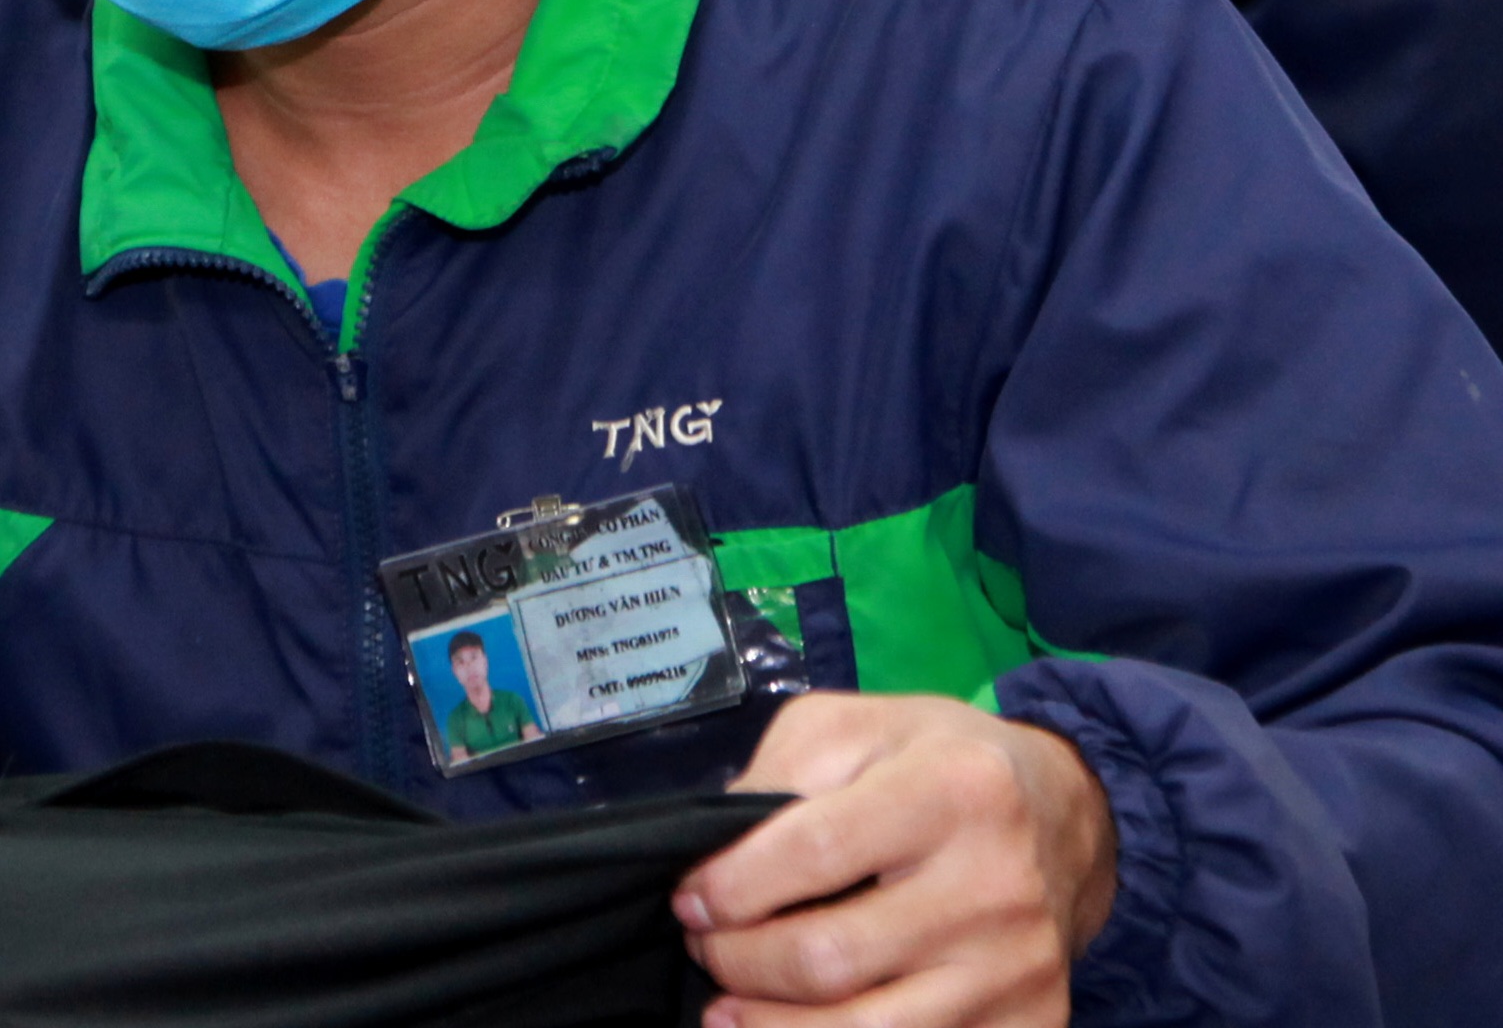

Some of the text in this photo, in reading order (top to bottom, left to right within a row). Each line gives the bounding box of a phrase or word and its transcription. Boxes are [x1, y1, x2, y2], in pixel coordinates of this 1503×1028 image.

[592, 401, 719, 458] TNG
[397, 546, 518, 614] TNG
[597, 555, 611, 570] &
[639, 538, 673, 558] TNG
